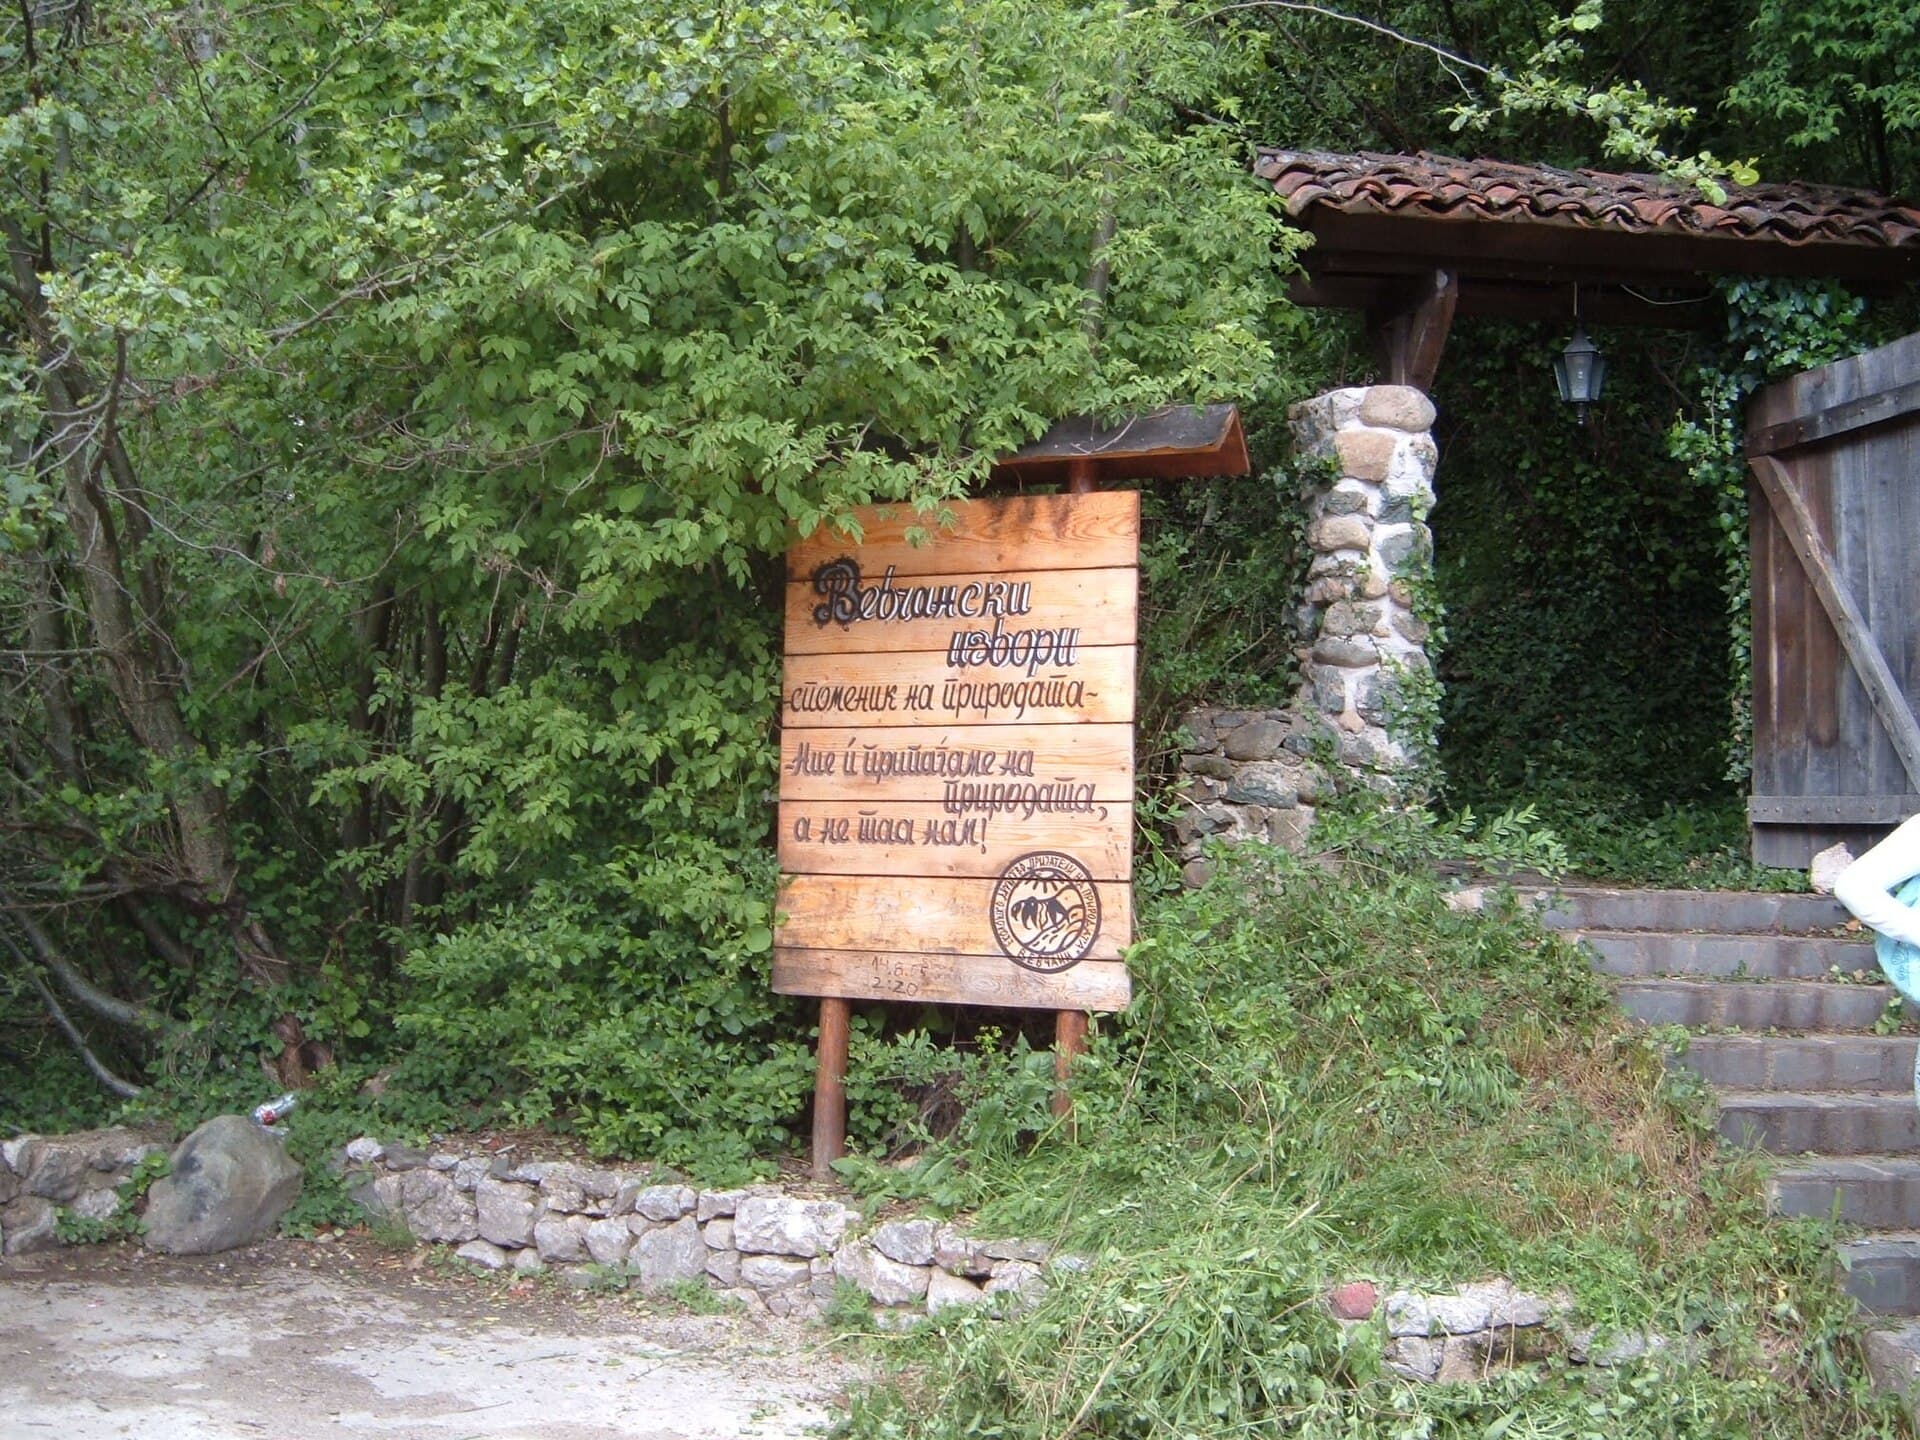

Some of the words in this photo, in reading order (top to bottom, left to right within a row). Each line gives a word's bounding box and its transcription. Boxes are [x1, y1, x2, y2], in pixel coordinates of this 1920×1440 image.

[812, 556, 1031, 625] Вевчански
[946, 617, 1080, 677] извори
[905, 685, 935, 711] на
[999, 748, 1035, 777] на
[793, 816, 811, 842] а
[820, 816, 850, 844] не
[858, 811, 915, 845] таа
[922, 817, 987, 854] нам!
